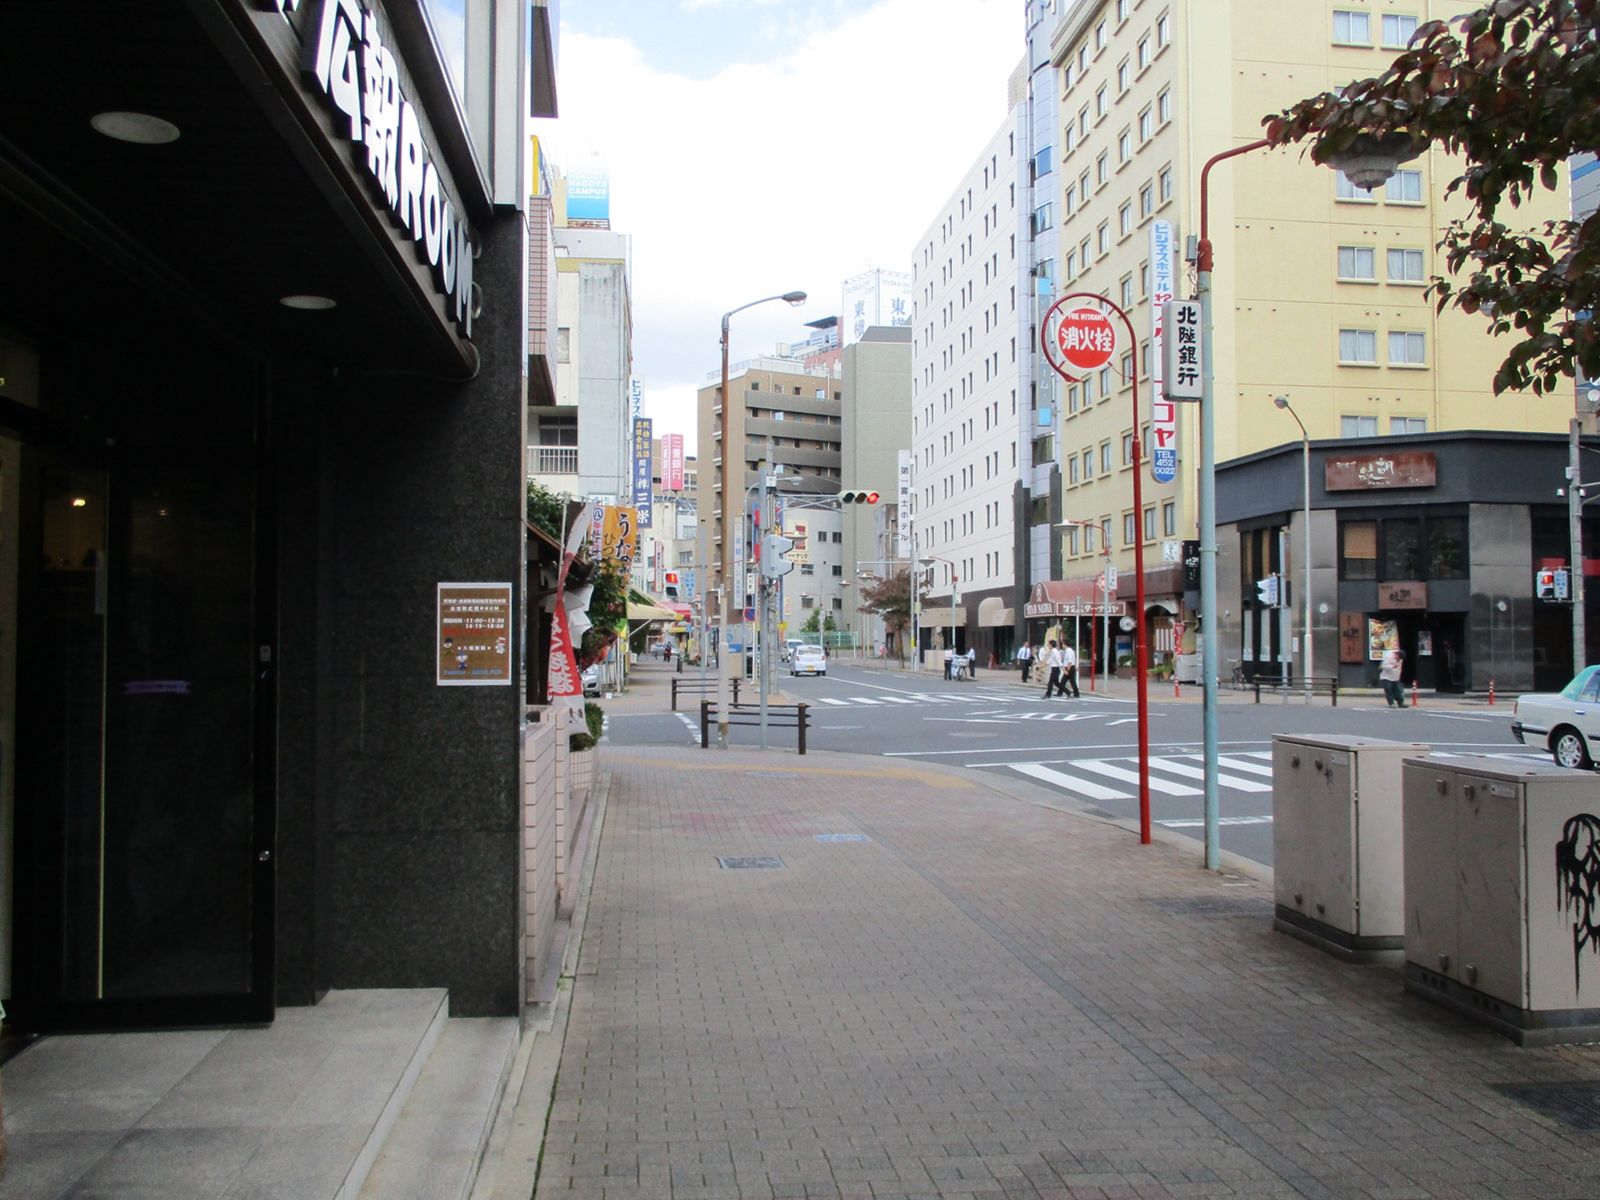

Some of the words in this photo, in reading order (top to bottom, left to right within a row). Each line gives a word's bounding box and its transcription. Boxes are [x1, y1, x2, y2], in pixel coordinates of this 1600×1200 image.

[1155, 223, 1169, 292] ビジネスホテル
[1080, 313, 1105, 321] HYDRANT
[1060, 326, 1113, 352] 消火栓
[1177, 306, 1199, 387] 北陸銀行
[672, 436, 682, 480] 三重銀行
[1156, 450, 1174, 459] TEL
[1156, 459, 1174, 467] 452
[1154, 466, 1176, 475] 0022
[900, 466, 909, 541] 第一富士ホテル
